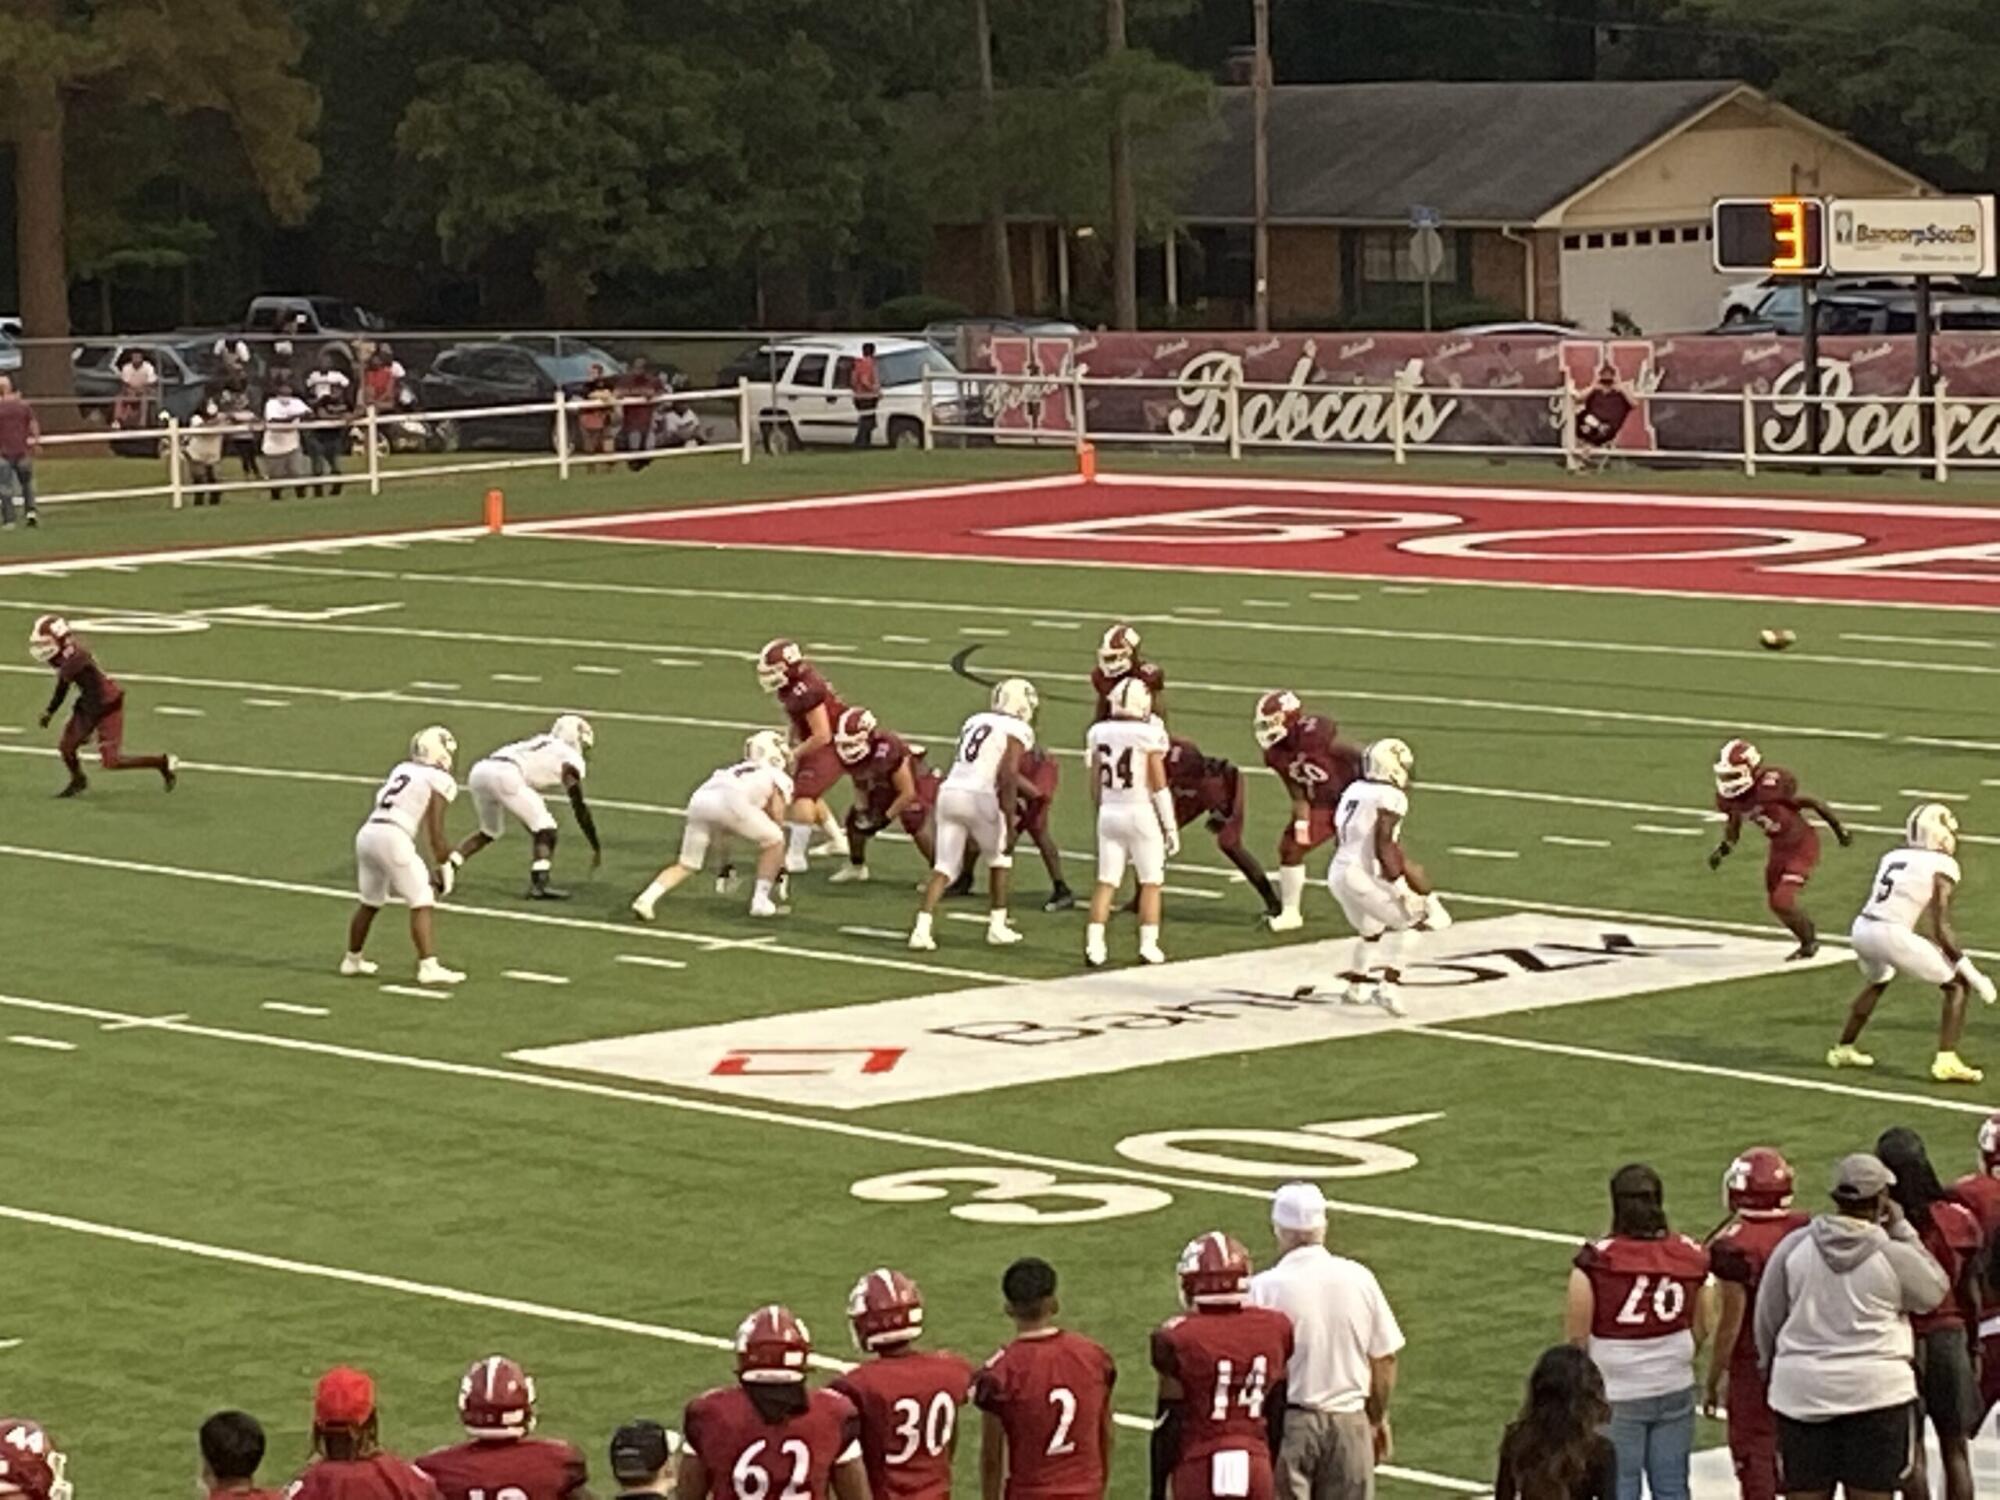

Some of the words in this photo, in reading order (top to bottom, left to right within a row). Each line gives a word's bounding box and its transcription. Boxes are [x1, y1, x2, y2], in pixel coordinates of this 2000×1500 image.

[1769, 201, 1805, 269] 3
[1856, 223, 1977, 247] BancorpSouth
[1168, 351, 1457, 442] Bobcats
[379, 773, 412, 810] 2
[1096, 743, 1134, 790] 64
[1875, 861, 1907, 904] 5
[1210, 1354, 1268, 1421] 14
[885, 1390, 956, 1465] 30
[1045, 1387, 1078, 1457] 2
[732, 1438, 813, 1500] 62
